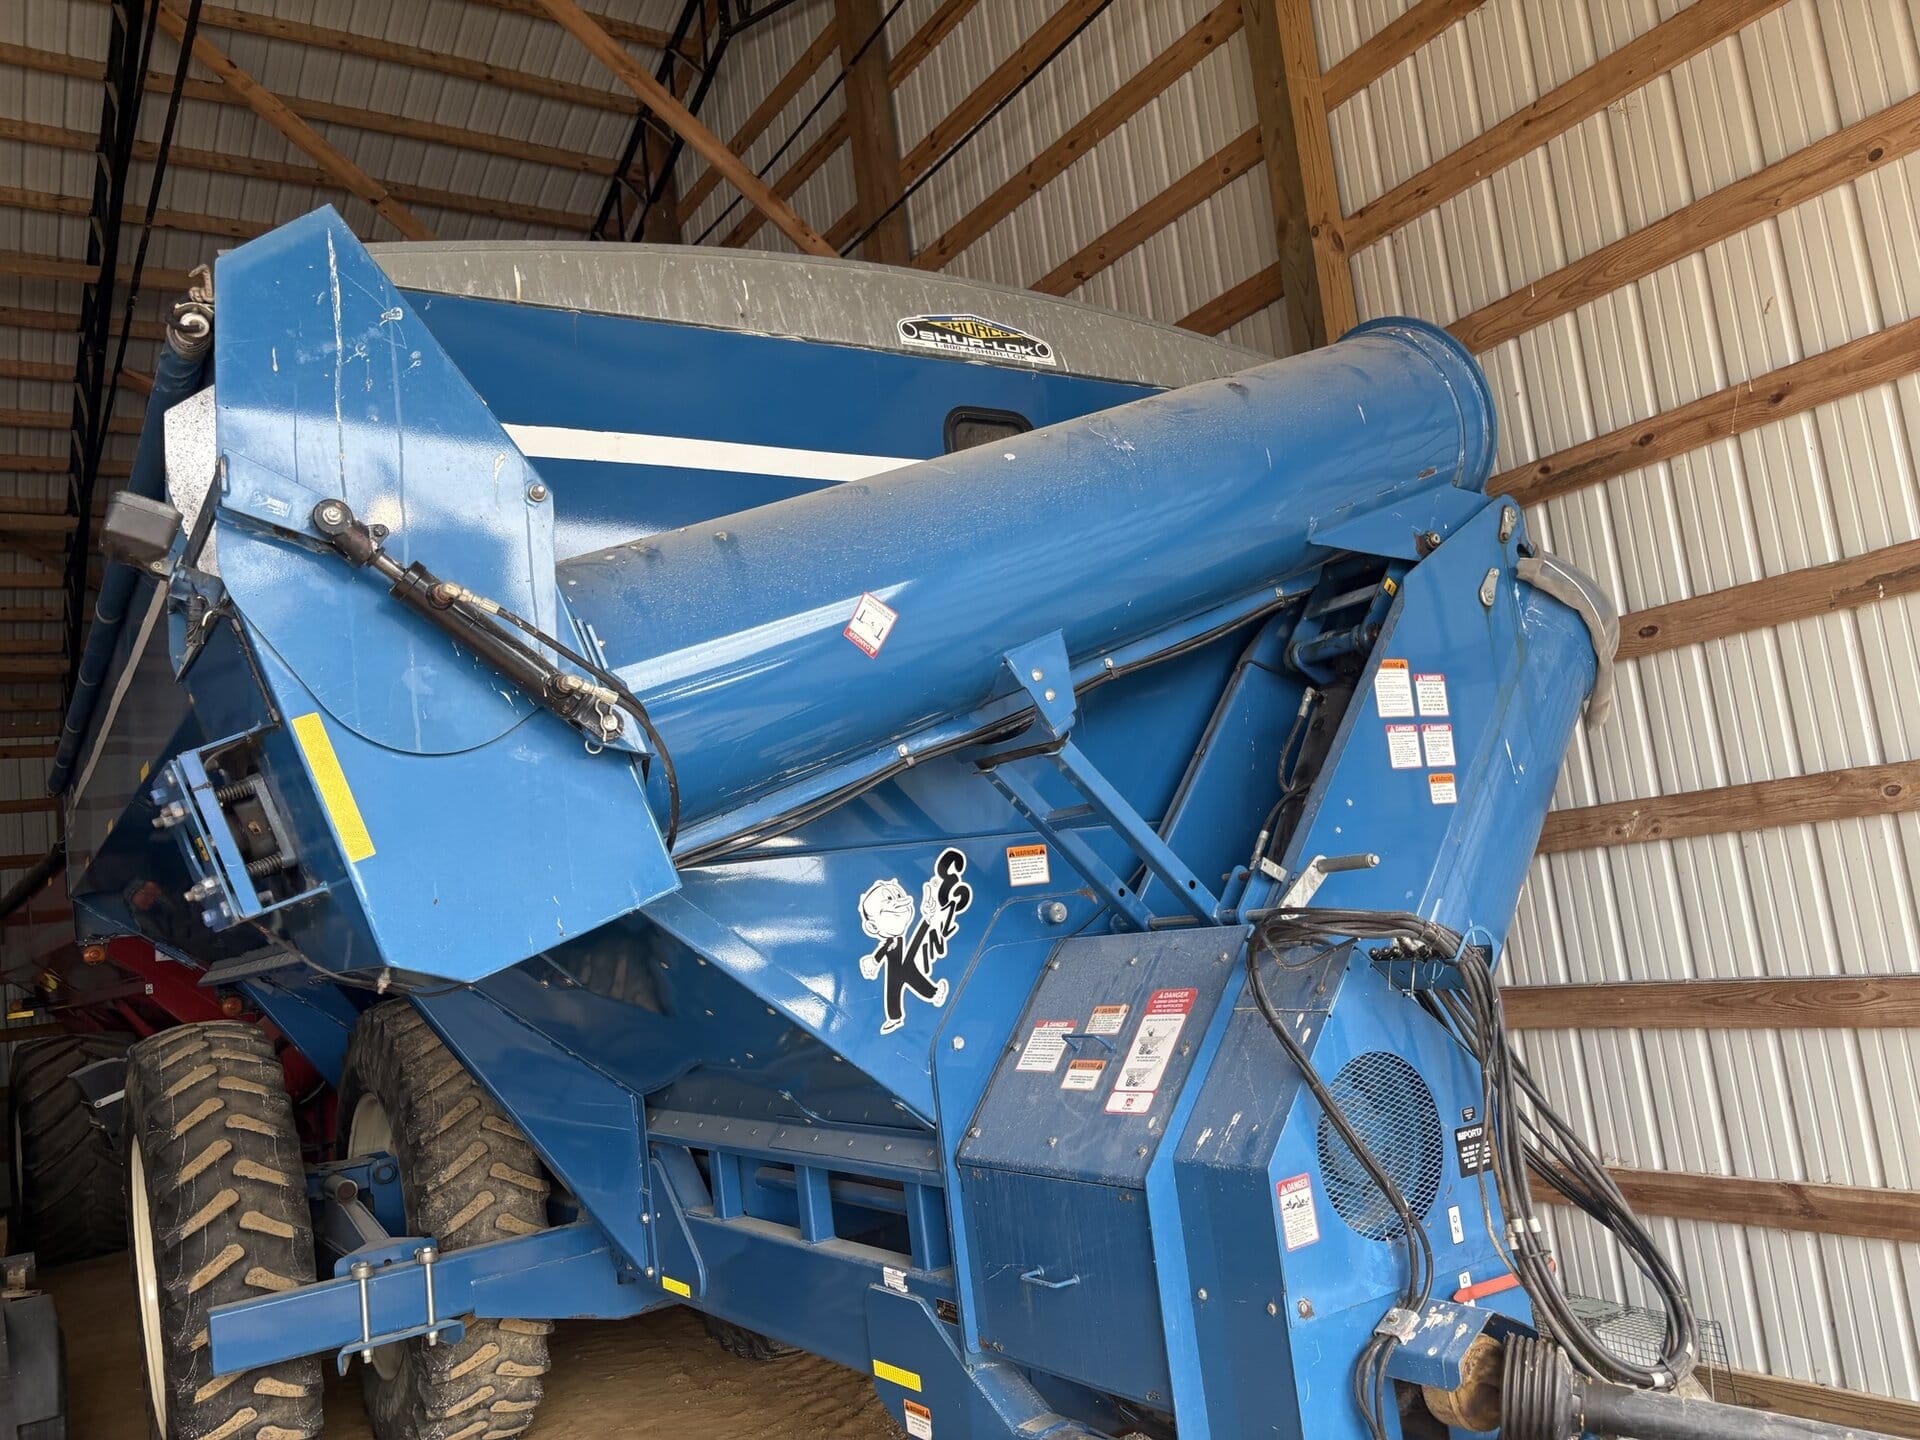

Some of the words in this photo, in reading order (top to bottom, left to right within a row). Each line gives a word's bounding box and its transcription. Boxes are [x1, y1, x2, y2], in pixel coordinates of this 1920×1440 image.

[942, 320, 1011, 338] SHURCO
[918, 330, 1036, 356] SHUR-LOK
[1396, 725, 1415, 733] DANGER
[1430, 724, 1449, 732] DANGER
[1015, 848, 1039, 857] WARNING
[1163, 991, 1190, 999] DANGER
[1457, 1127, 1483, 1141] IMPORTA
[1287, 1178, 1308, 1192] DANGER
